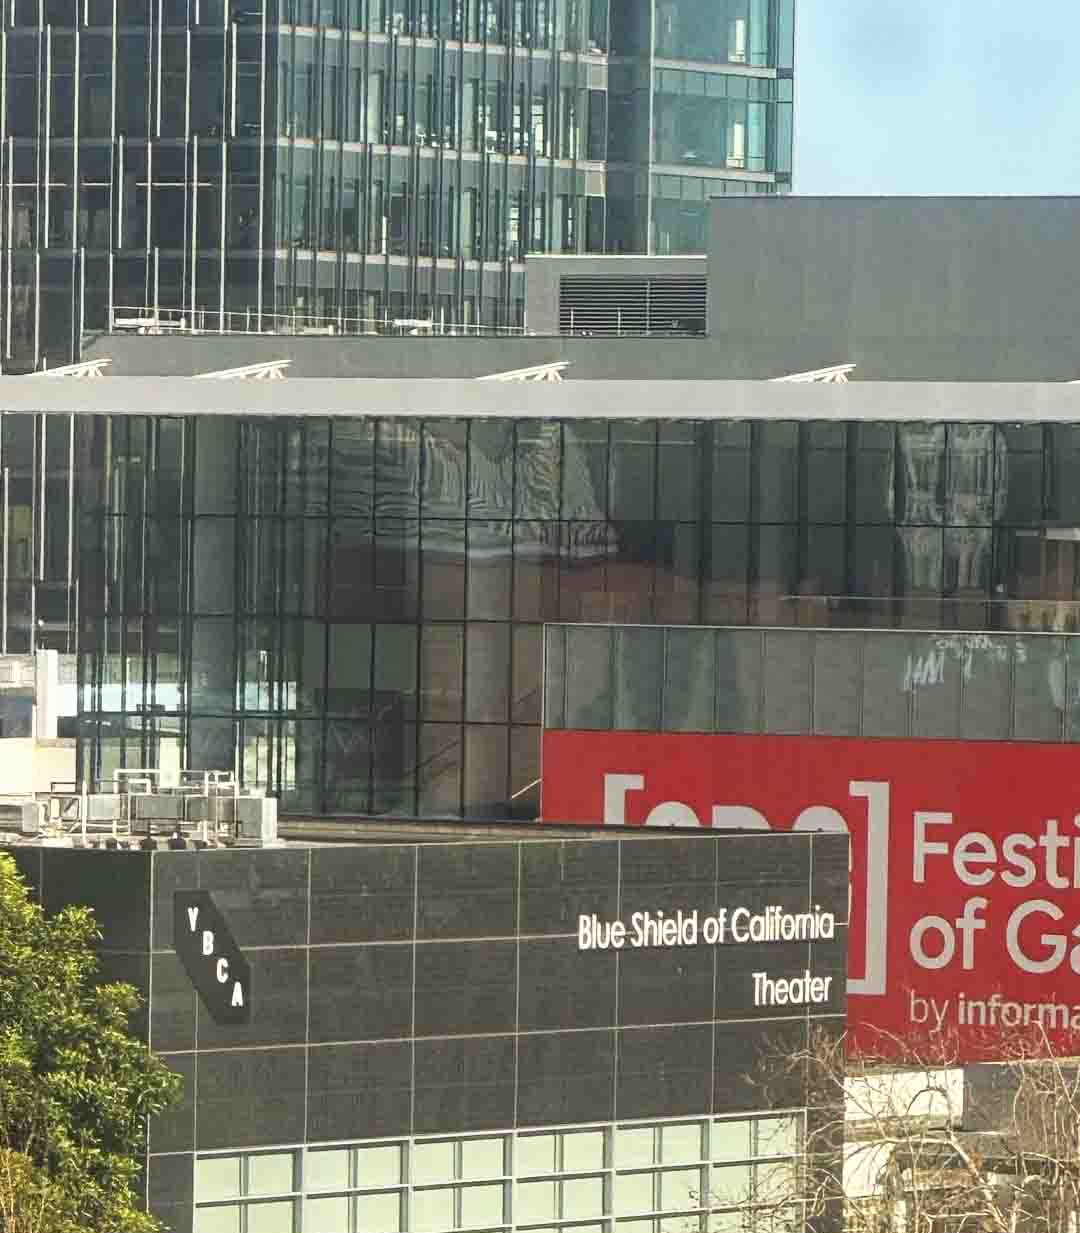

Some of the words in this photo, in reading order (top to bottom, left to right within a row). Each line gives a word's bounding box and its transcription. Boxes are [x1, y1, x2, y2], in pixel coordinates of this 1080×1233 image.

[578, 913, 625, 950] Blue
[630, 909, 698, 947] Shield
[703, 908, 728, 944] of
[731, 904, 835, 942] California
[909, 896, 990, 970] of
[752, 969, 833, 1006] Theater
[909, 989, 949, 1032] by
